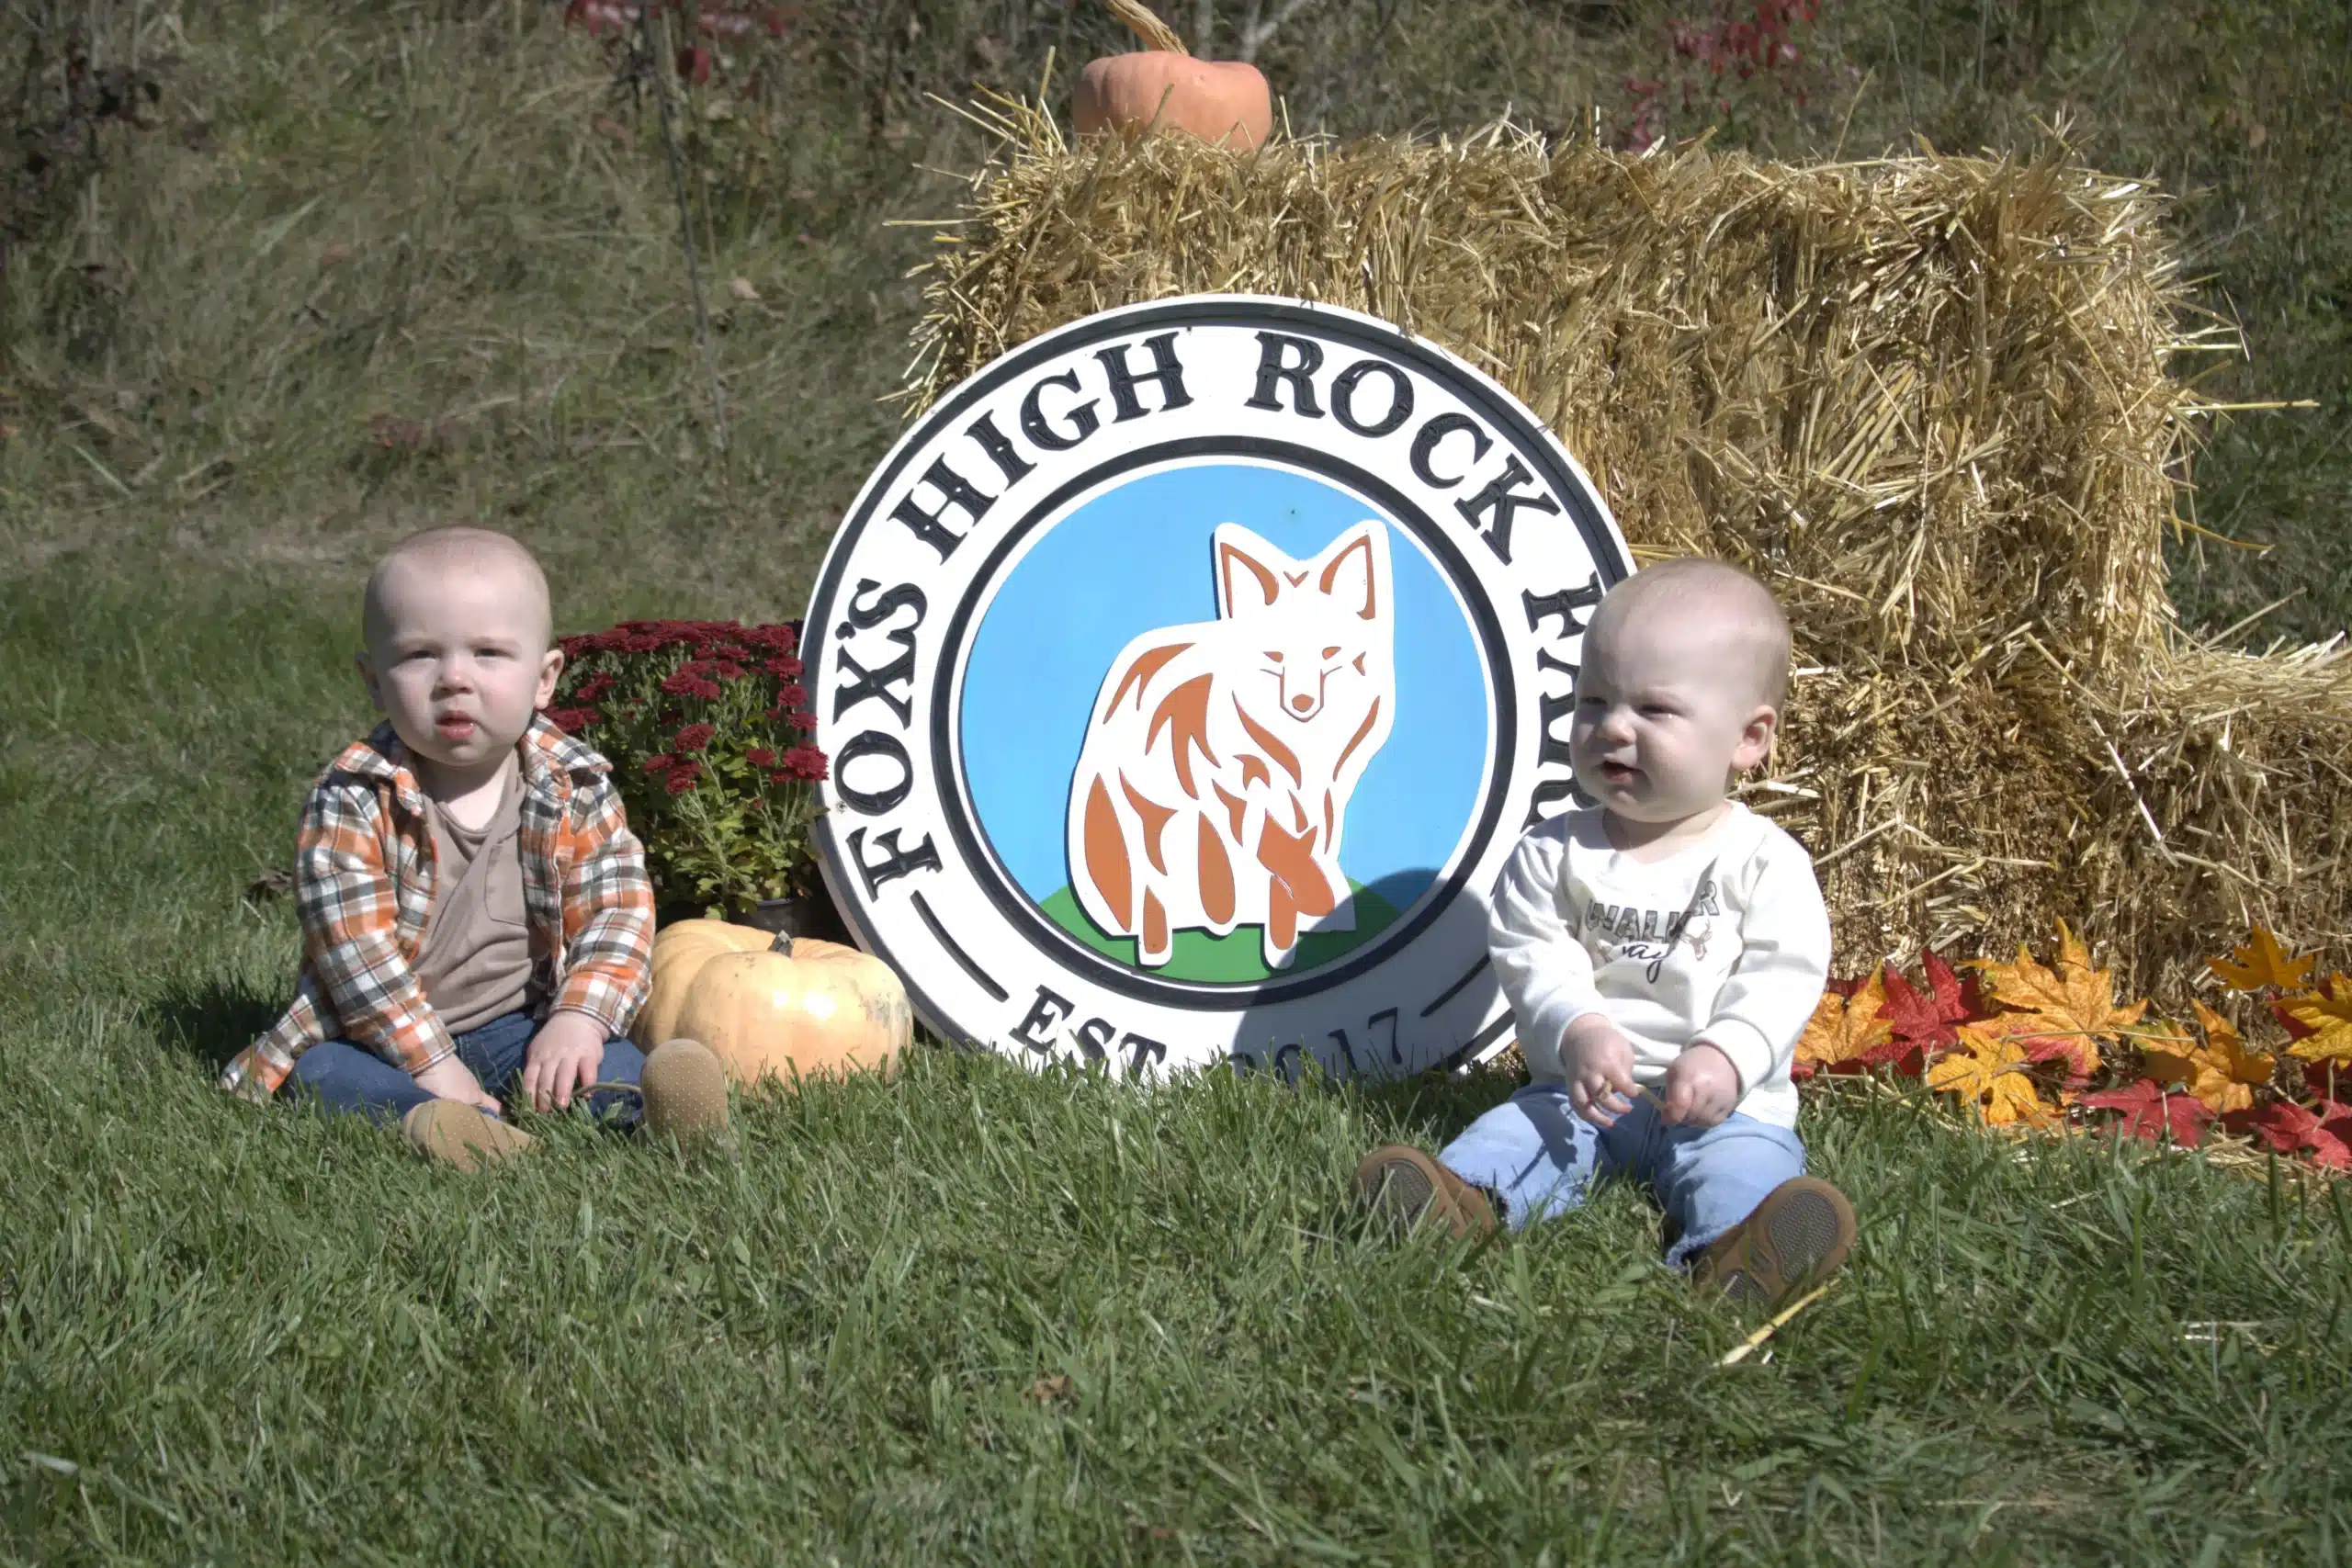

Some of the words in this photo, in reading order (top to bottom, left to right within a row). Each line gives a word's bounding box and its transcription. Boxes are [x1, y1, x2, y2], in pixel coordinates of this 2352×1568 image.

[832, 578, 944, 903] FOX'S
[888, 331, 1194, 566] HIGH
[1244, 331, 1561, 567] ROCK
[1009, 984, 1168, 1082] EST
